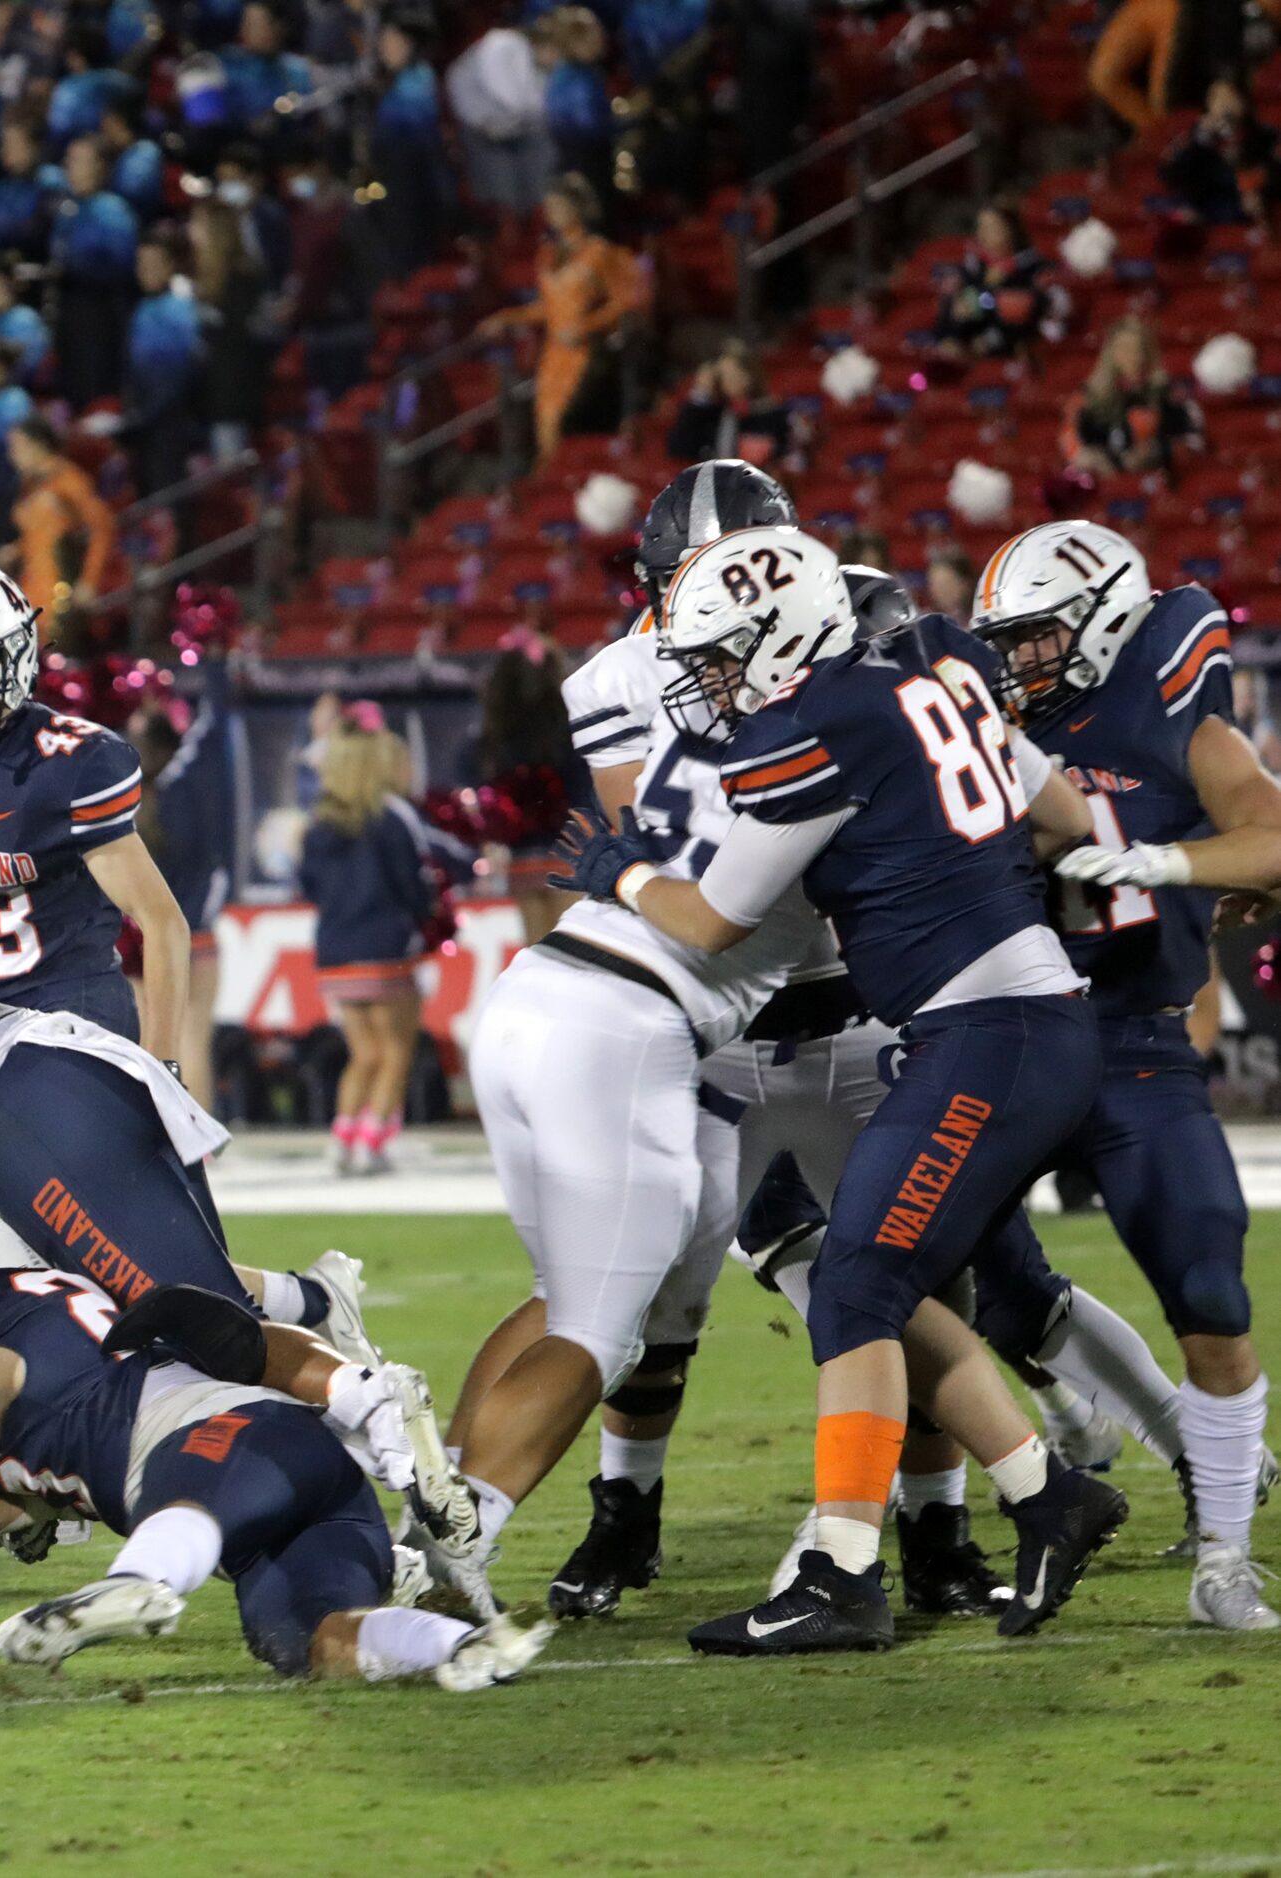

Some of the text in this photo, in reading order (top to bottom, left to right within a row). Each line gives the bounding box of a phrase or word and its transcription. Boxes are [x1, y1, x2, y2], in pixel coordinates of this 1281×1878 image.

[721, 549, 796, 606] 82
[1055, 536, 1107, 580] 11
[35, 714, 102, 758] 43
[894, 655, 1031, 846] 82
[874, 1094, 993, 1250] WAKELAND
[32, 1177, 157, 1305] AKELAND
[805, 1585, 832, 1601] ALPHA
